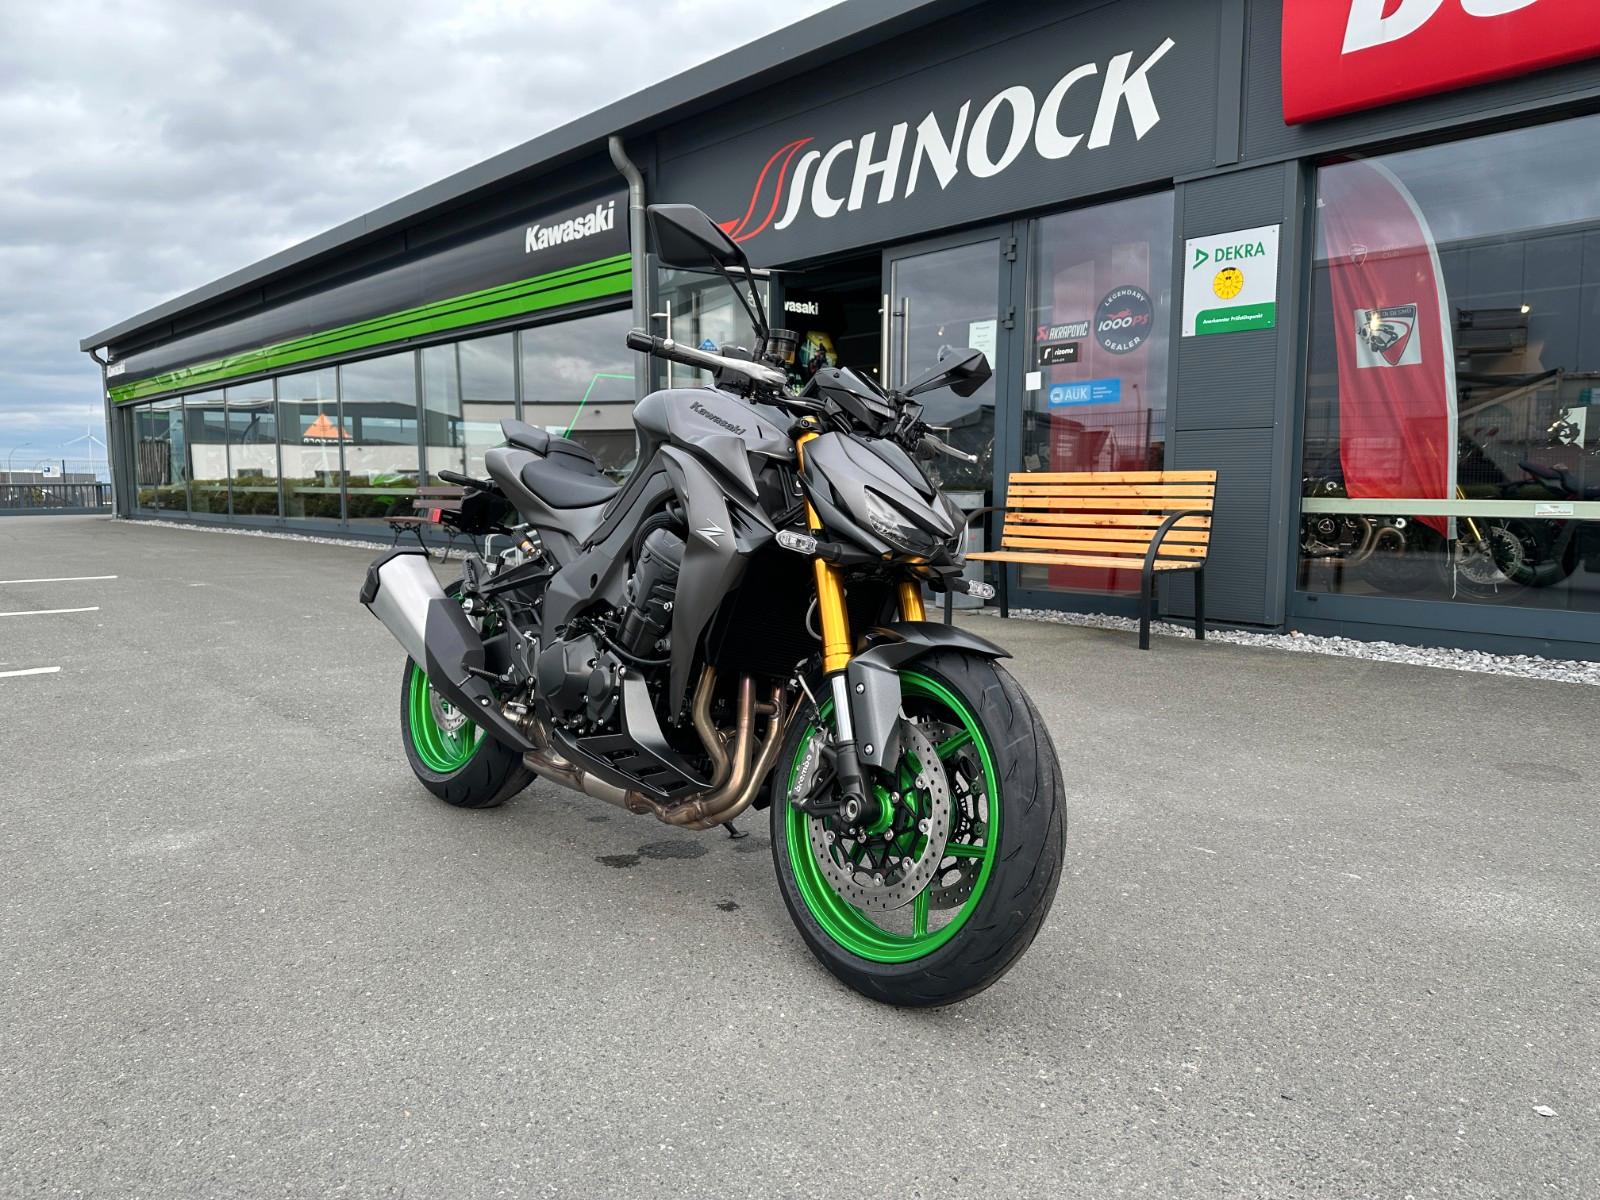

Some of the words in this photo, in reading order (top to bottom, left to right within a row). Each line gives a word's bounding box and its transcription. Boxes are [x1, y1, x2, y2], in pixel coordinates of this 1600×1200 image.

[773, 37, 1176, 230] SCHNOCK
[525, 200, 615, 254] Kawasaki
[1214, 240, 1266, 263] DEKRA
[1104, 288, 1146, 307] LEGENDARY
[1098, 313, 1150, 332] 1000PS
[1104, 336, 1141, 352] DEALER
[1064, 386, 1088, 401] AUK
[689, 401, 747, 436] Kawasaki
[794, 753, 813, 793] brembo
